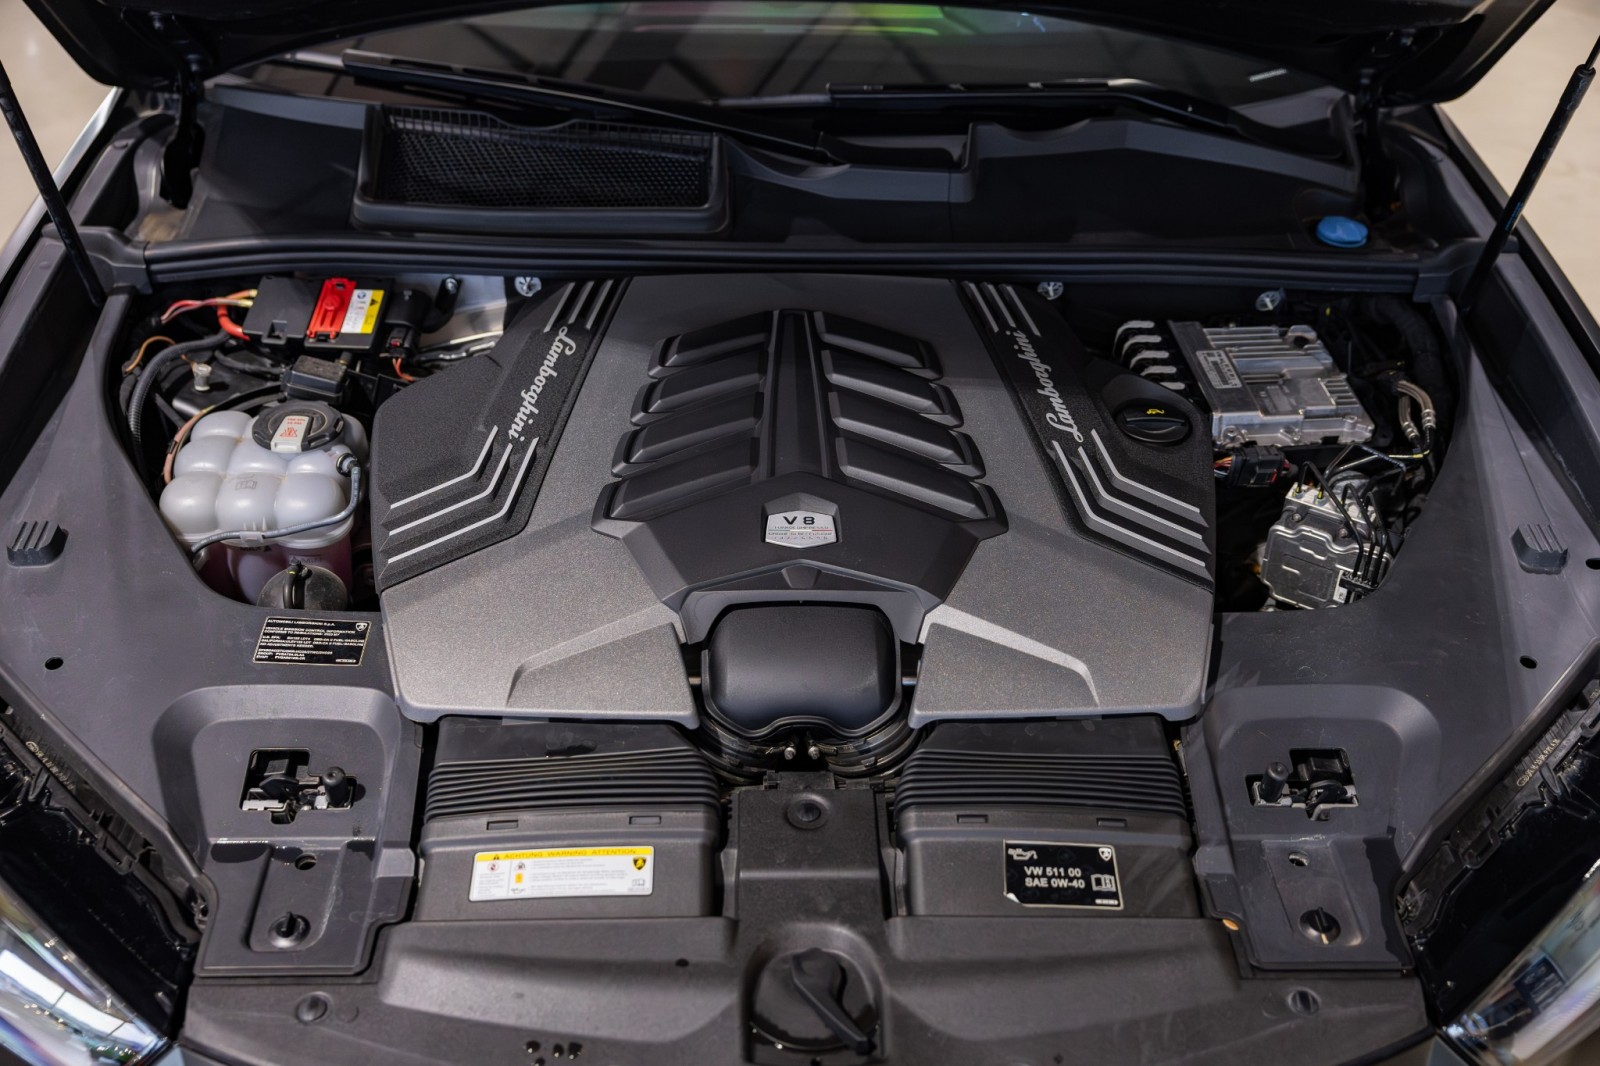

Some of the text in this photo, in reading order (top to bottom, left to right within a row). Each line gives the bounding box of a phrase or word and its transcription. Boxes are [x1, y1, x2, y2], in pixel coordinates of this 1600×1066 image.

[508, 326, 576, 441] Lamborghini
[1005, 330, 1084, 443] Lamborghini
[1024, 866, 1082, 877] VW 511 00
[1024, 878, 1085, 889] SAE 0W-40
